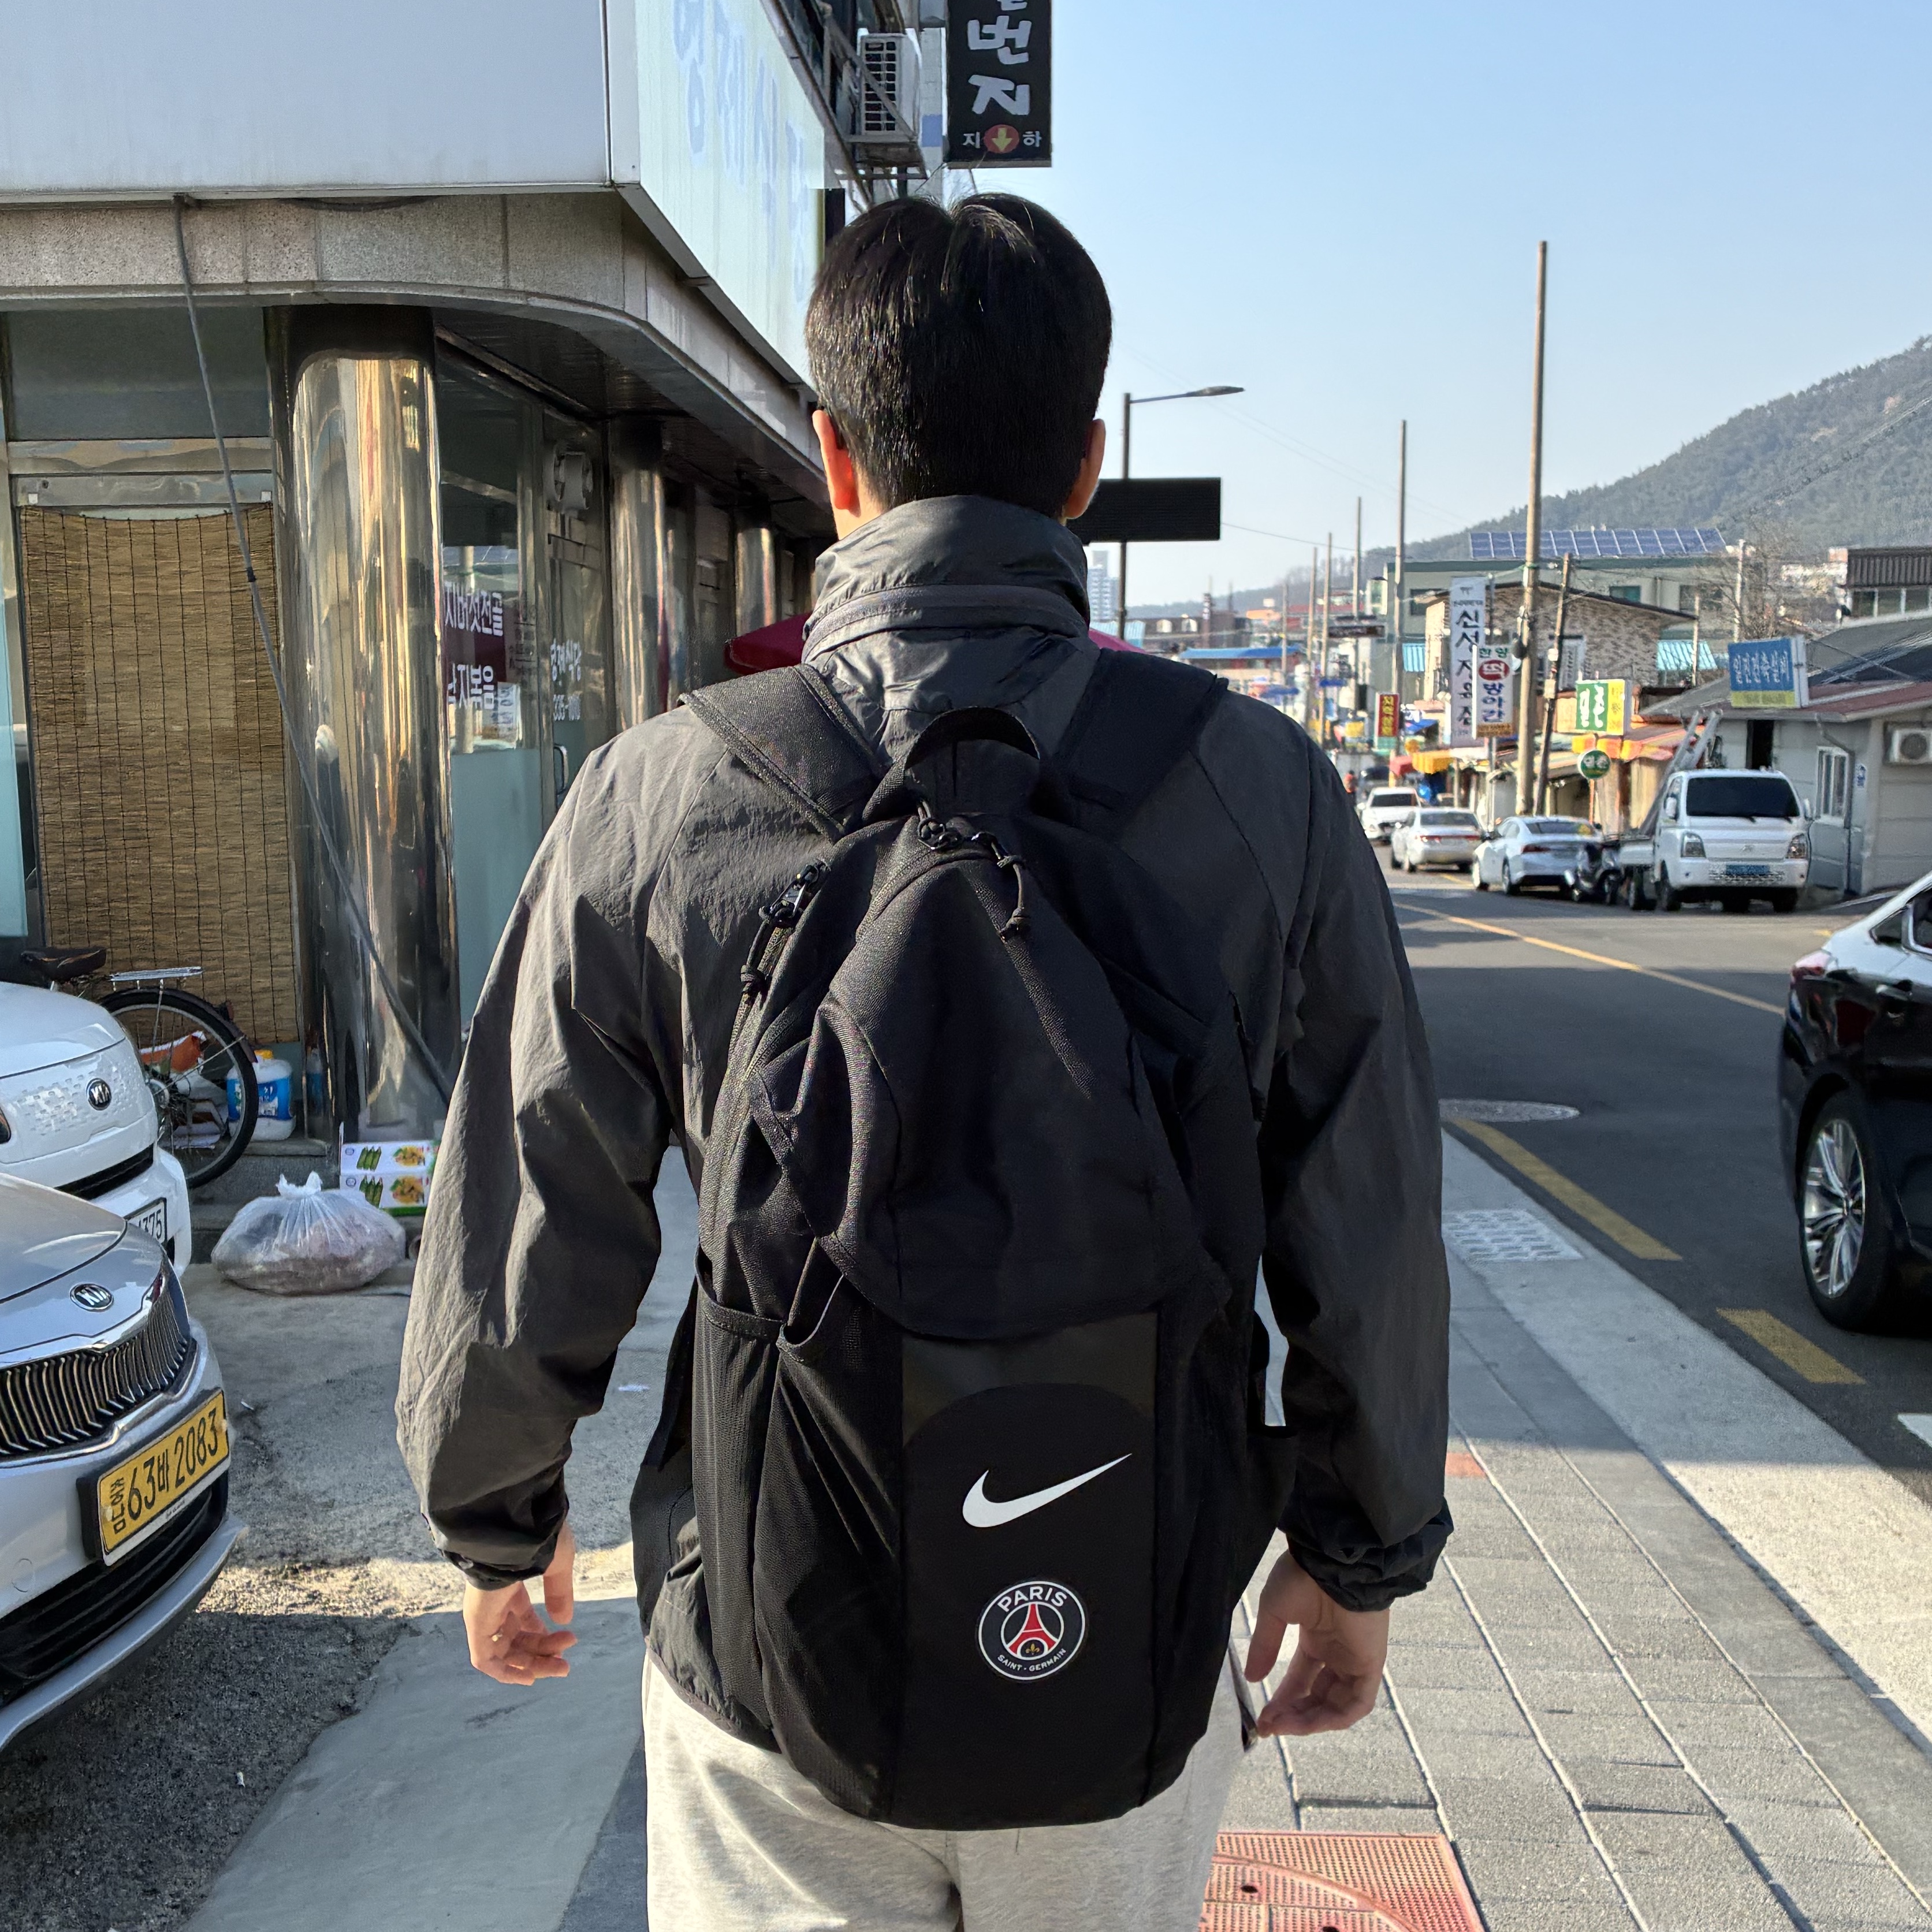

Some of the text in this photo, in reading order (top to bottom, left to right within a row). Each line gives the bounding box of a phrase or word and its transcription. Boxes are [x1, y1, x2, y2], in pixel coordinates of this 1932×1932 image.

[963, 131, 1042, 148] 지 하
[139, 1209, 162, 1240] 375
[128, 1449, 169, 1521] 63바
[174, 1407, 218, 1488] 2083
[997, 1586, 1067, 1613] PARIS
